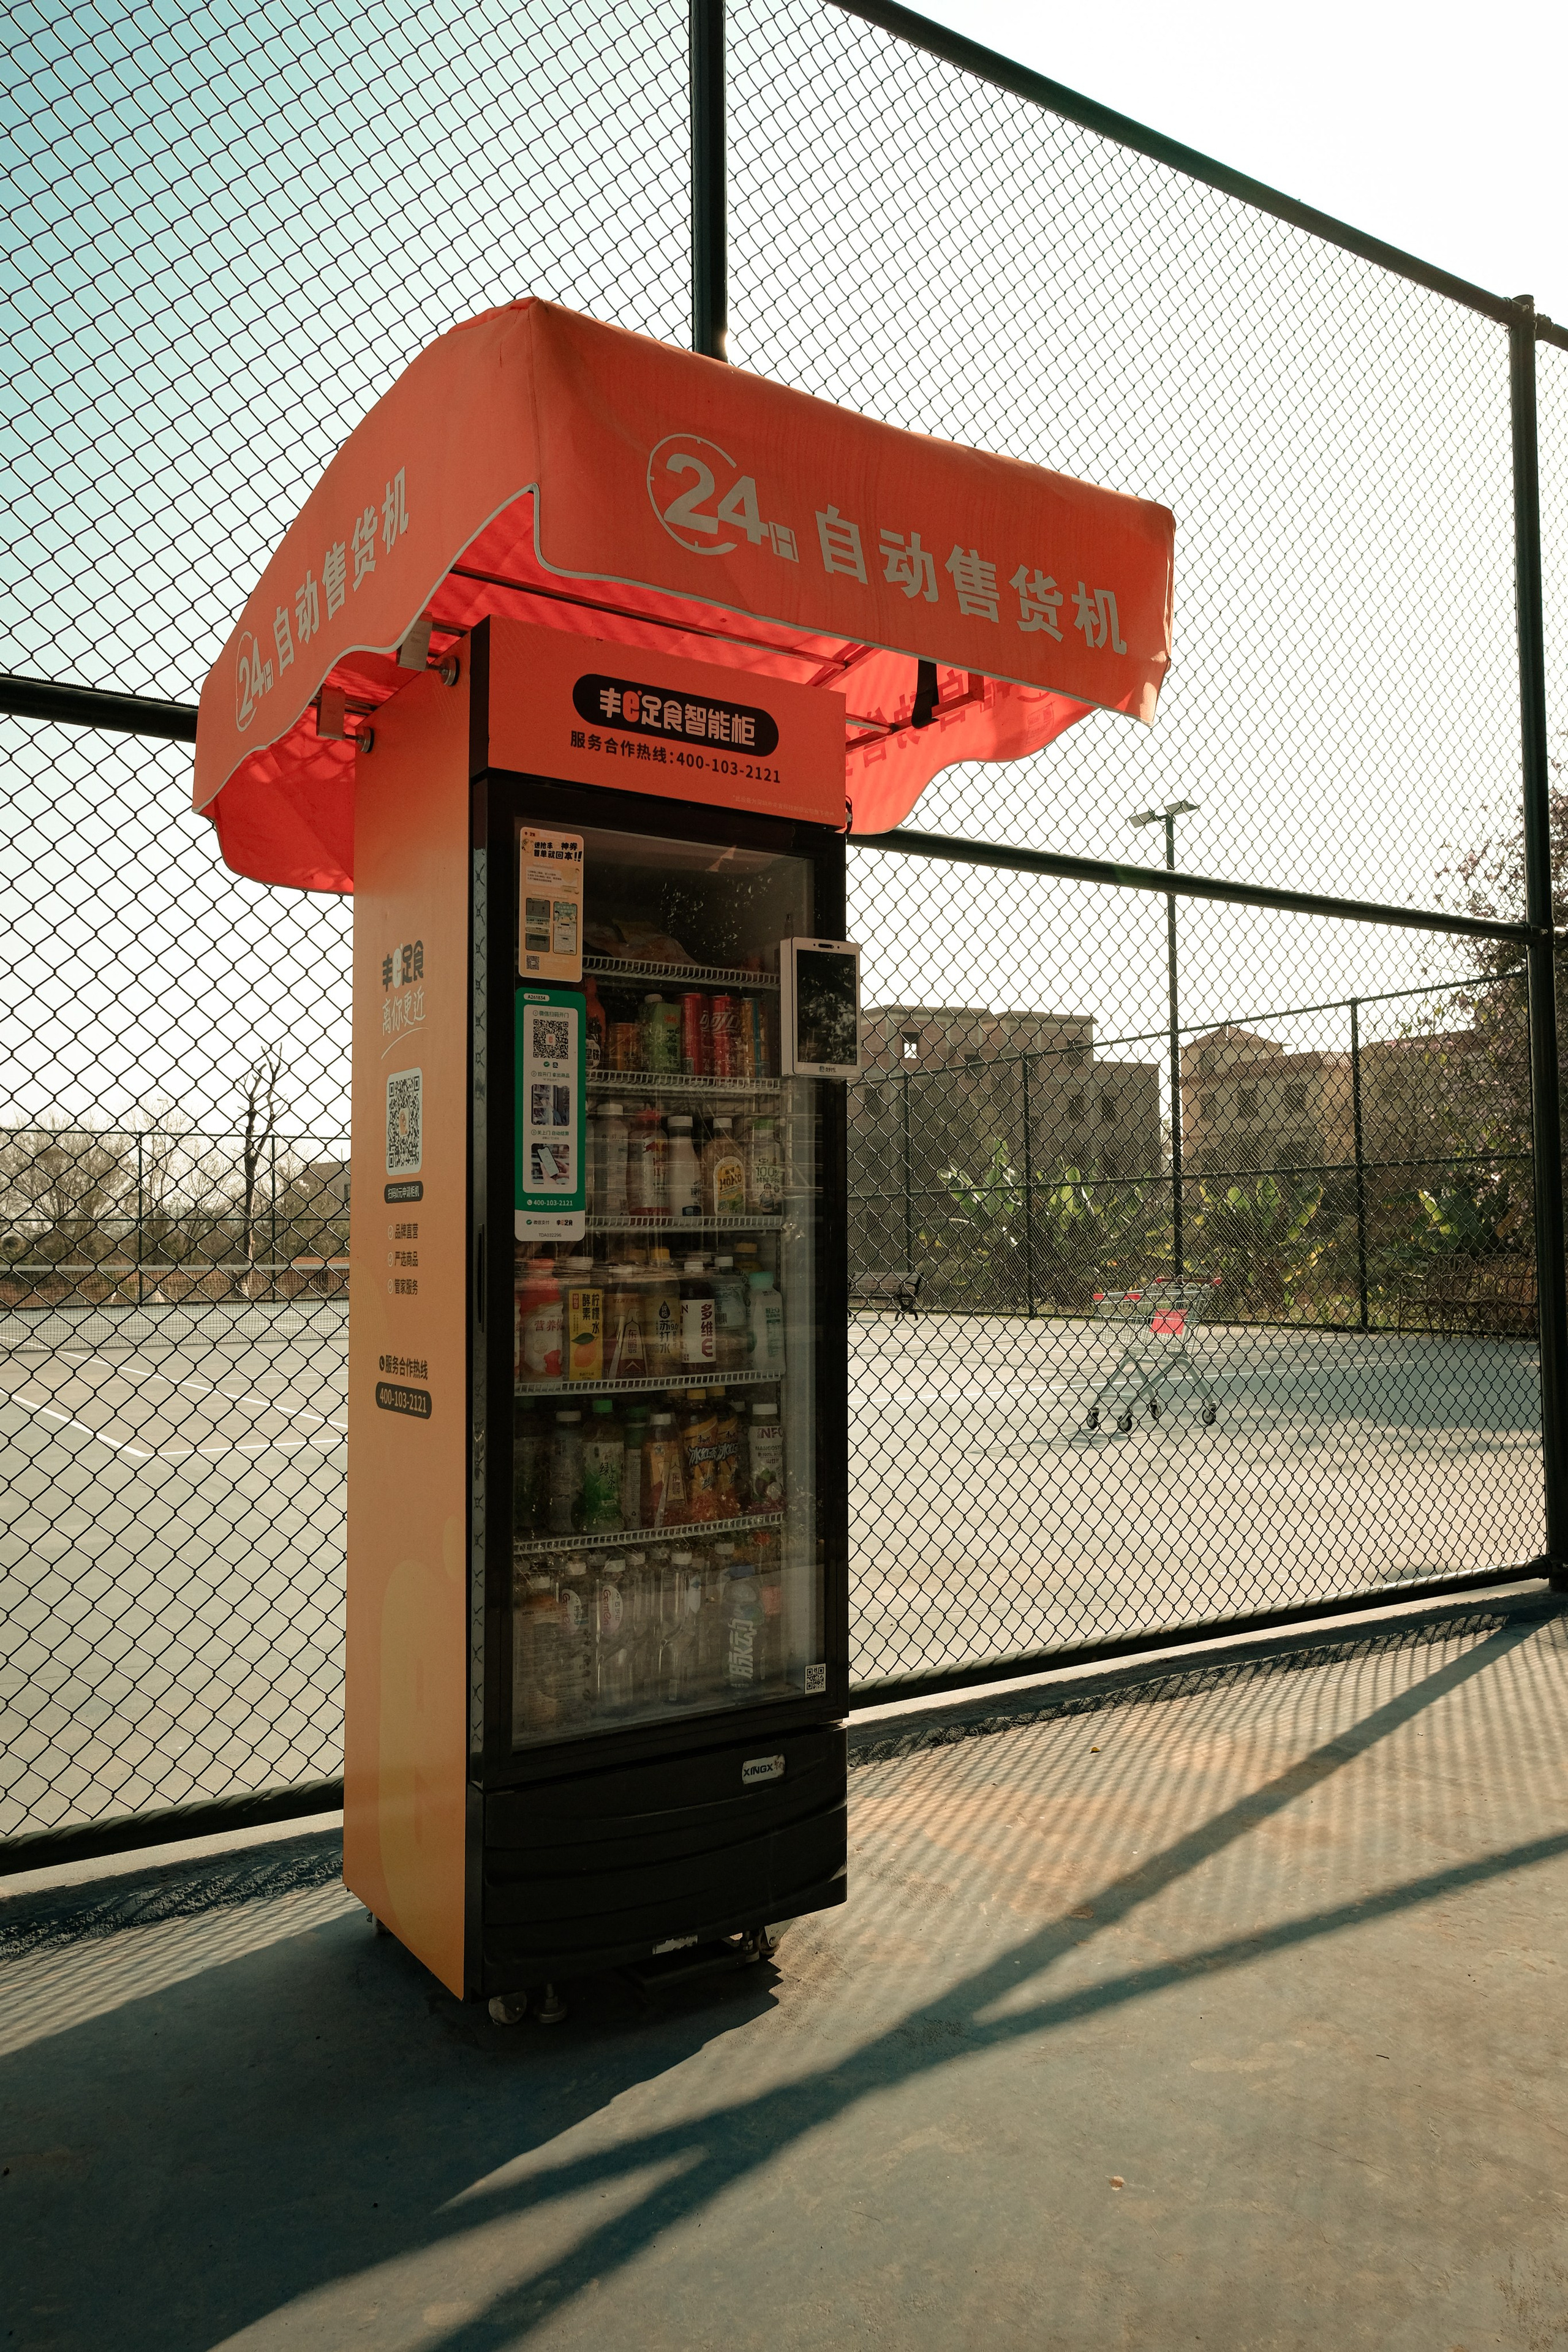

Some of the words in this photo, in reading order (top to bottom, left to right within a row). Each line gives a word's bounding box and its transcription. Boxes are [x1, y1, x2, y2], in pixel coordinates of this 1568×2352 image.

[273, 466, 409, 677] 自动售货机
[815, 504, 1128, 657] 自动售货机
[599, 687, 756, 747] 丰e足食智能柜
[382, 939, 424, 992] 丰e足食
[382, 986, 426, 1036] 离你更近
[395, 1223, 418, 1240] 品牌直营
[394, 1251, 418, 1267] 严选商品
[394, 1279, 418, 1295] 管家服务
[385, 1355, 428, 1380] 服务合作热线
[380, 1387, 427, 1414] 400-103-2121
[728, 1618, 757, 1679] 脉动
